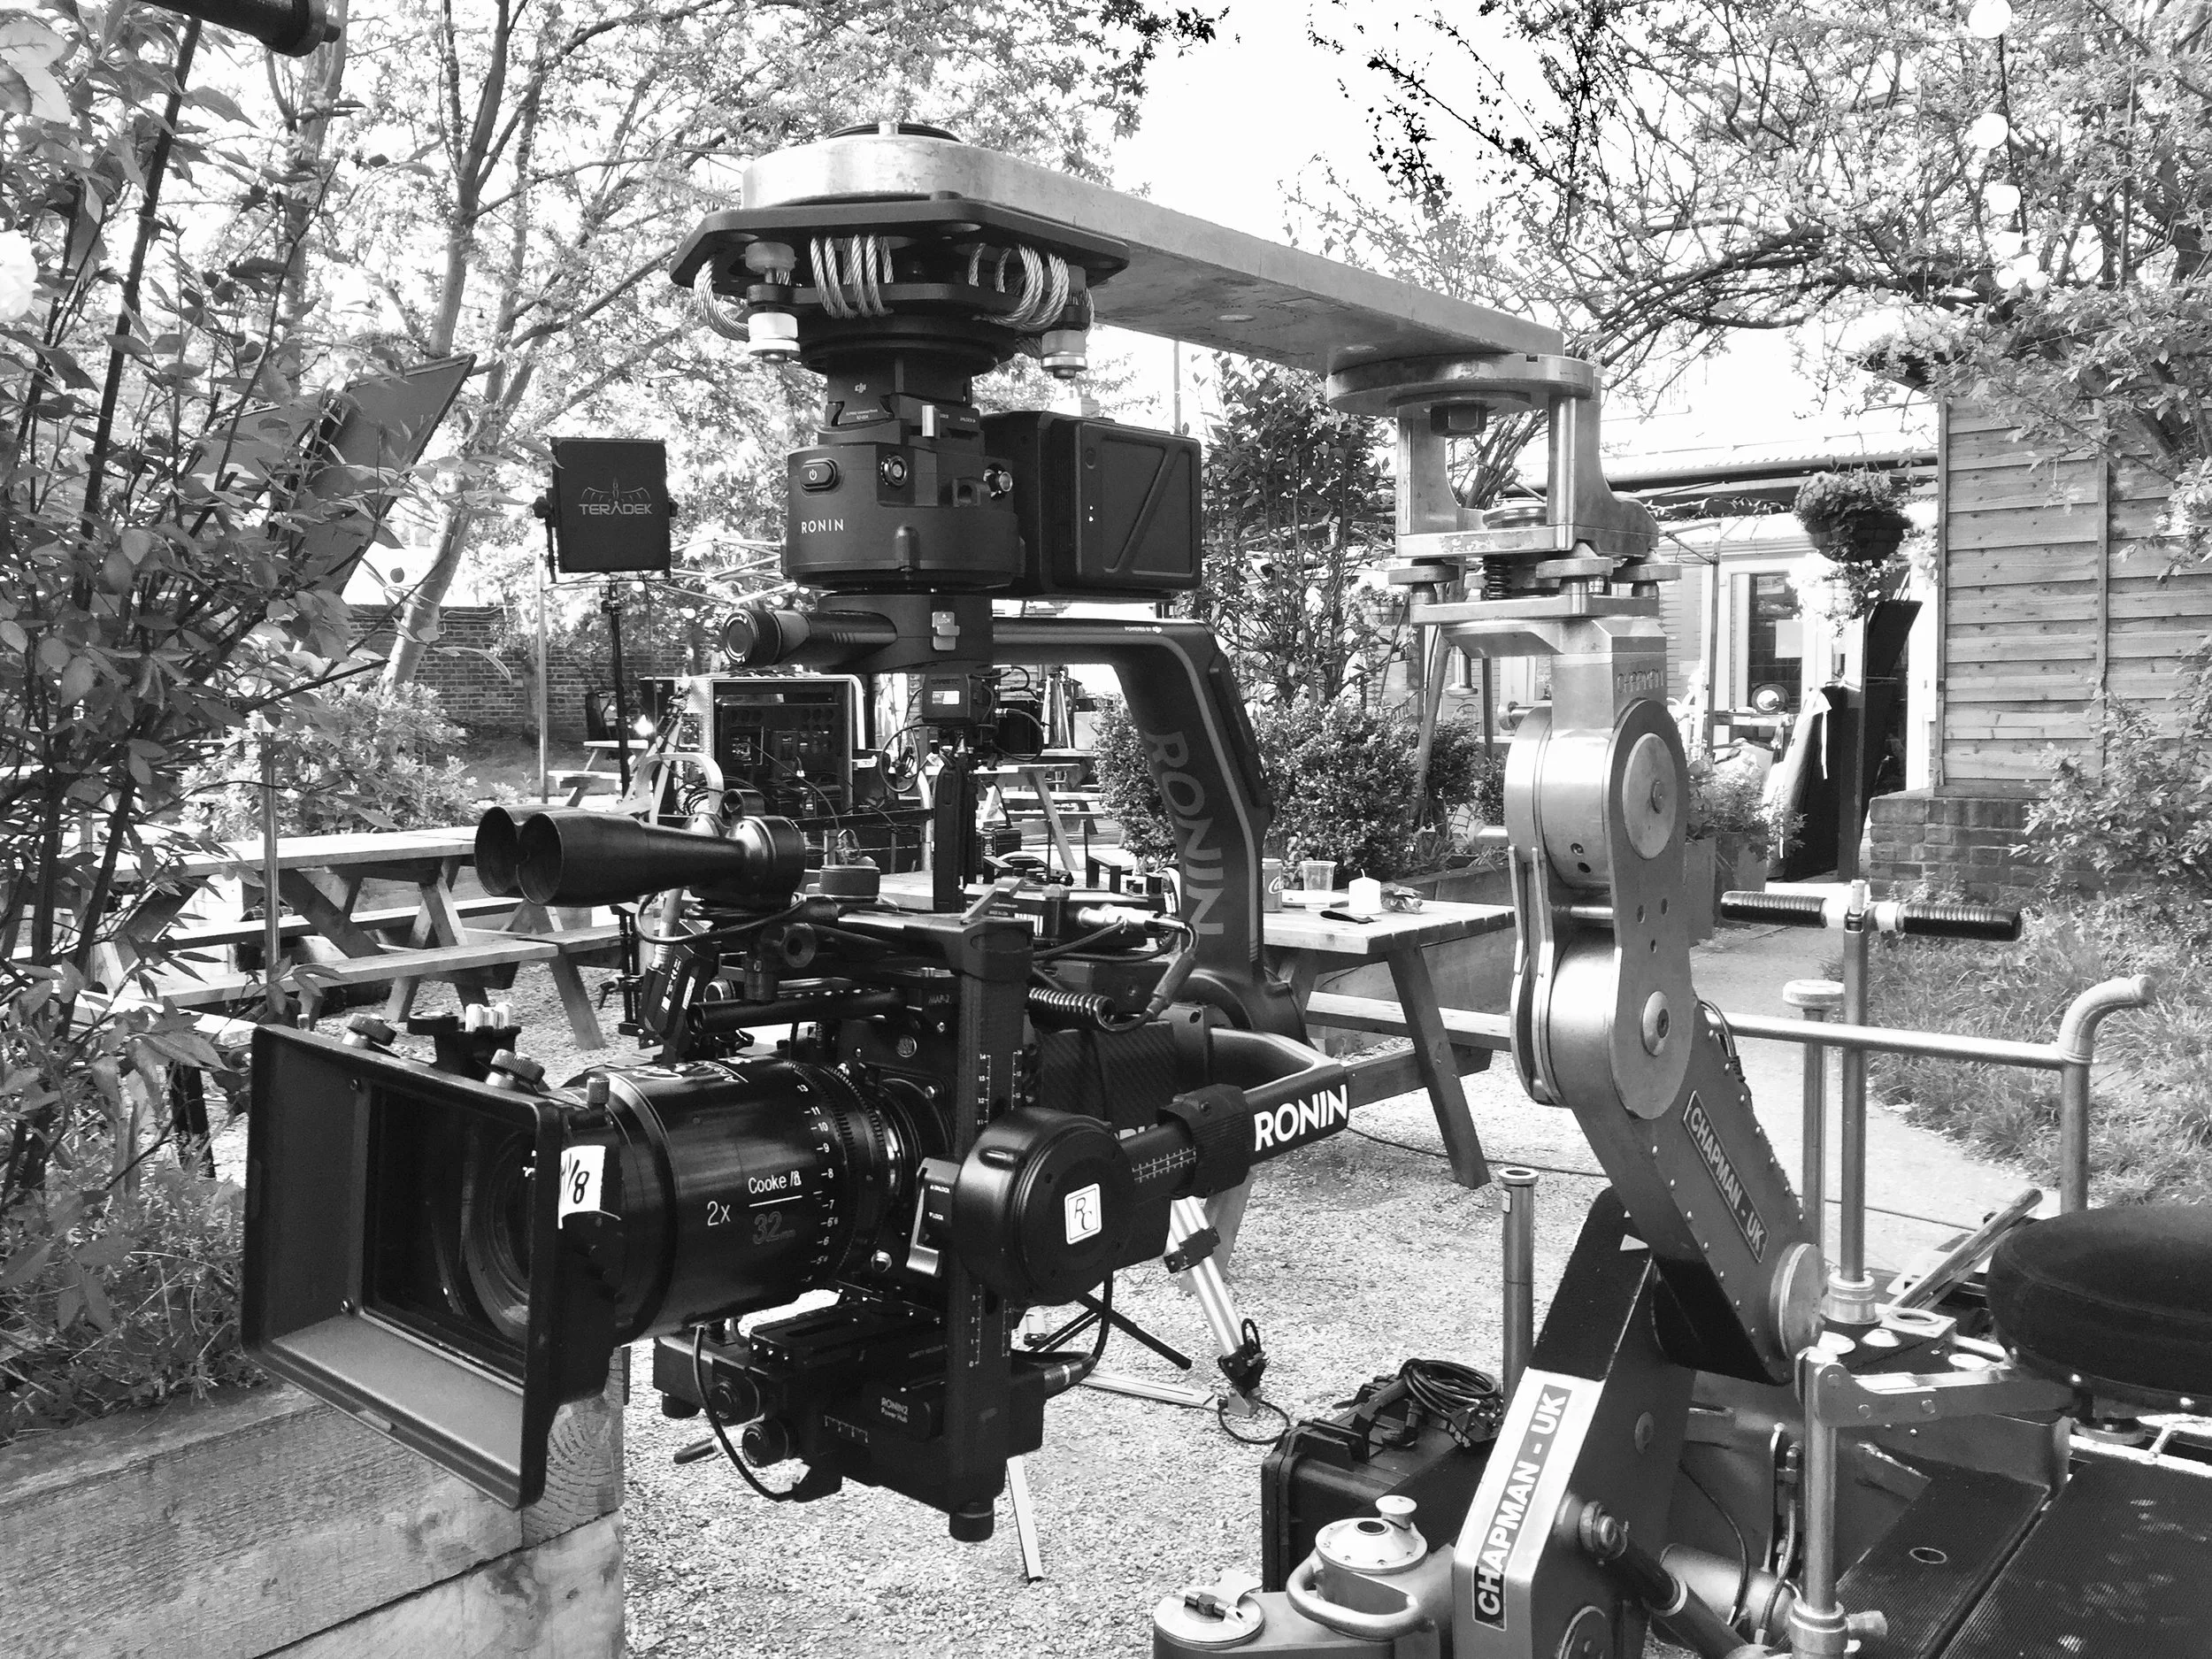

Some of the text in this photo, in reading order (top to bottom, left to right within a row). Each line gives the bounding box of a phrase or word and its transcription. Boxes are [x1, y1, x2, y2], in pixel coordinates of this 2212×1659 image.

[578, 501, 653, 516] TERADEK
[801, 518, 844, 534] RONIN
[1144, 730, 1225, 935] RONIN
[1254, 1084, 1348, 1152] RONIN
[748, 1174, 787, 1194] Cooke
[1691, 1107, 1743, 1210] CHAPMAN
[1747, 1210, 1765, 1252] UK
[707, 1201, 731, 1226] 2x
[1478, 1461, 1541, 1617] CHAPMAN
[1530, 1392, 1567, 1435] UK
